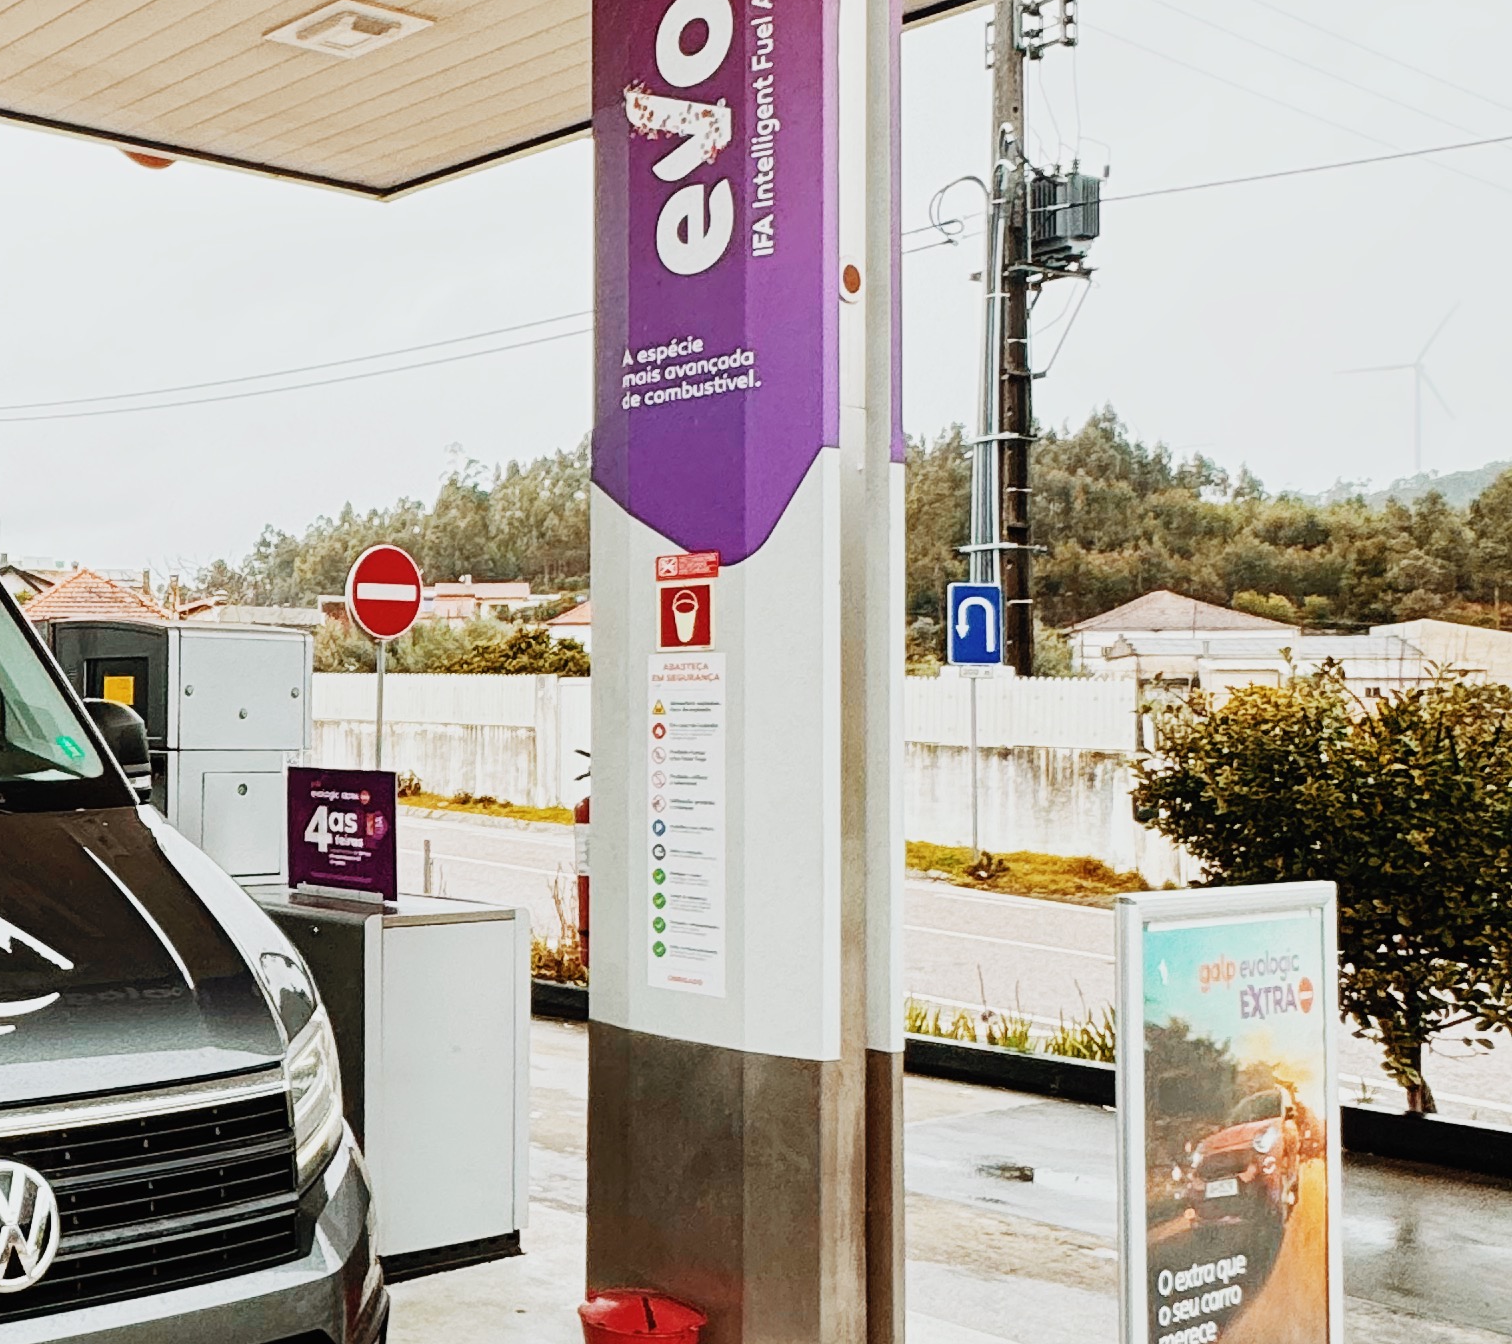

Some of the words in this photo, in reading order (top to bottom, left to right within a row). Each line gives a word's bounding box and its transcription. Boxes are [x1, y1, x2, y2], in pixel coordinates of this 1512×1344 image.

[751, 16, 775, 72] Fuel
[751, 74, 780, 208] Intelligent
[752, 213, 775, 257] IFA
[621, 348, 634, 368] A
[636, 335, 704, 365] espécie
[622, 365, 661, 389] mais
[664, 348, 755, 381] avançada
[621, 391, 642, 411] de
[644, 368, 763, 406] combustível.
[1199, 952, 1236, 994] galp
[1239, 947, 1300, 982] evologic
[1239, 983, 1298, 1020] EXTRA
[1157, 1269, 1173, 1297] O
[1174, 1262, 1216, 1292] extra
[1216, 1253, 1248, 1285] que
[1158, 1305, 1172, 1327] o
[1172, 1296, 1199, 1323] seu
[1199, 1285, 1242, 1312] carro
